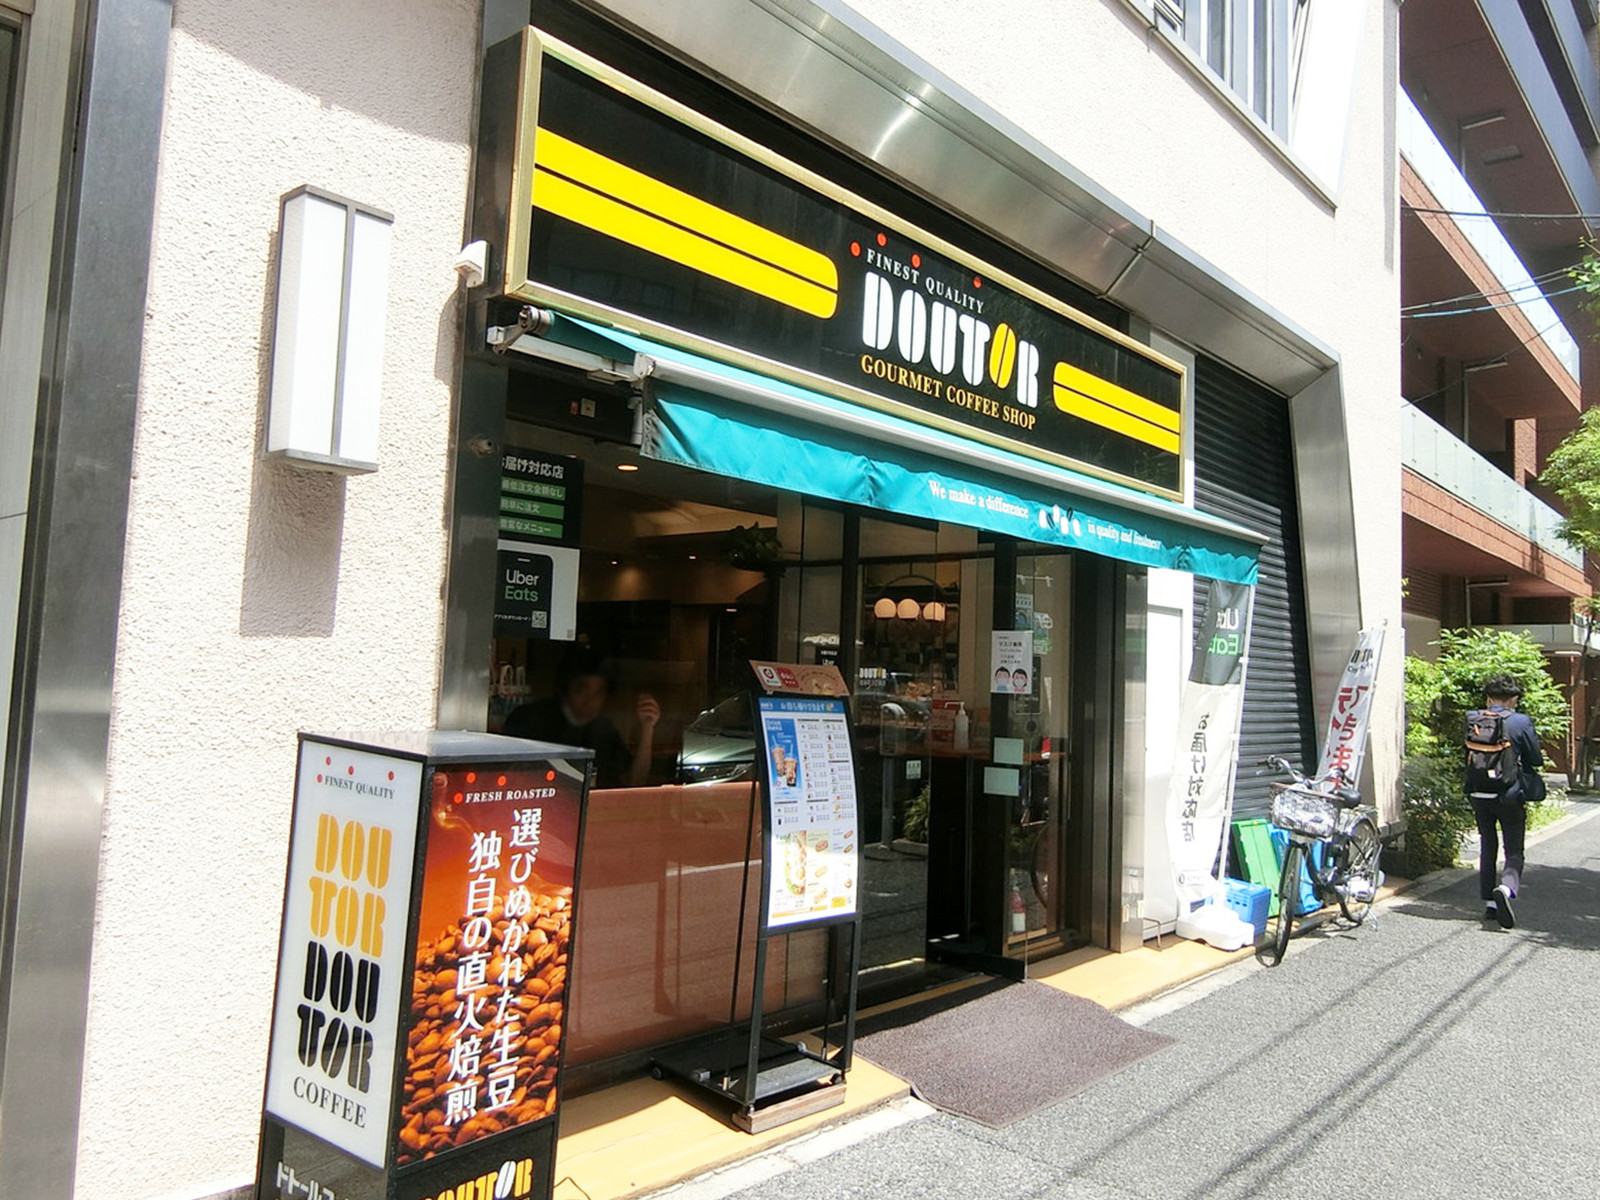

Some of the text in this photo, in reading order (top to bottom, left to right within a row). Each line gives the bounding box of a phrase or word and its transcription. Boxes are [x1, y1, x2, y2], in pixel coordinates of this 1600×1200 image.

[866, 248, 984, 314] FINEST QUALITY
[862, 271, 1040, 408] DOUTOR
[861, 354, 1036, 430] GOURMET COFFEE SHOP
[928, 479, 947, 500] We
[949, 488, 977, 506] make
[978, 496, 986, 508] a
[986, 495, 1030, 519] difference
[505, 585, 539, 602] Eats
[506, 569, 539, 586] Uber
[325, 775, 395, 800] FINEST QUALITY
[465, 788, 556, 803] FRESH ROASTED
[316, 813, 393, 889] DOU
[309, 876, 386, 957] TOR
[304, 940, 381, 1024] DOU
[444, 830, 502, 1126] 独自の直火焙煎
[485, 808, 541, 1112] 選びぬかれた生豆
[297, 1003, 373, 1094] TOR
[293, 1076, 367, 1130] COFFEE
